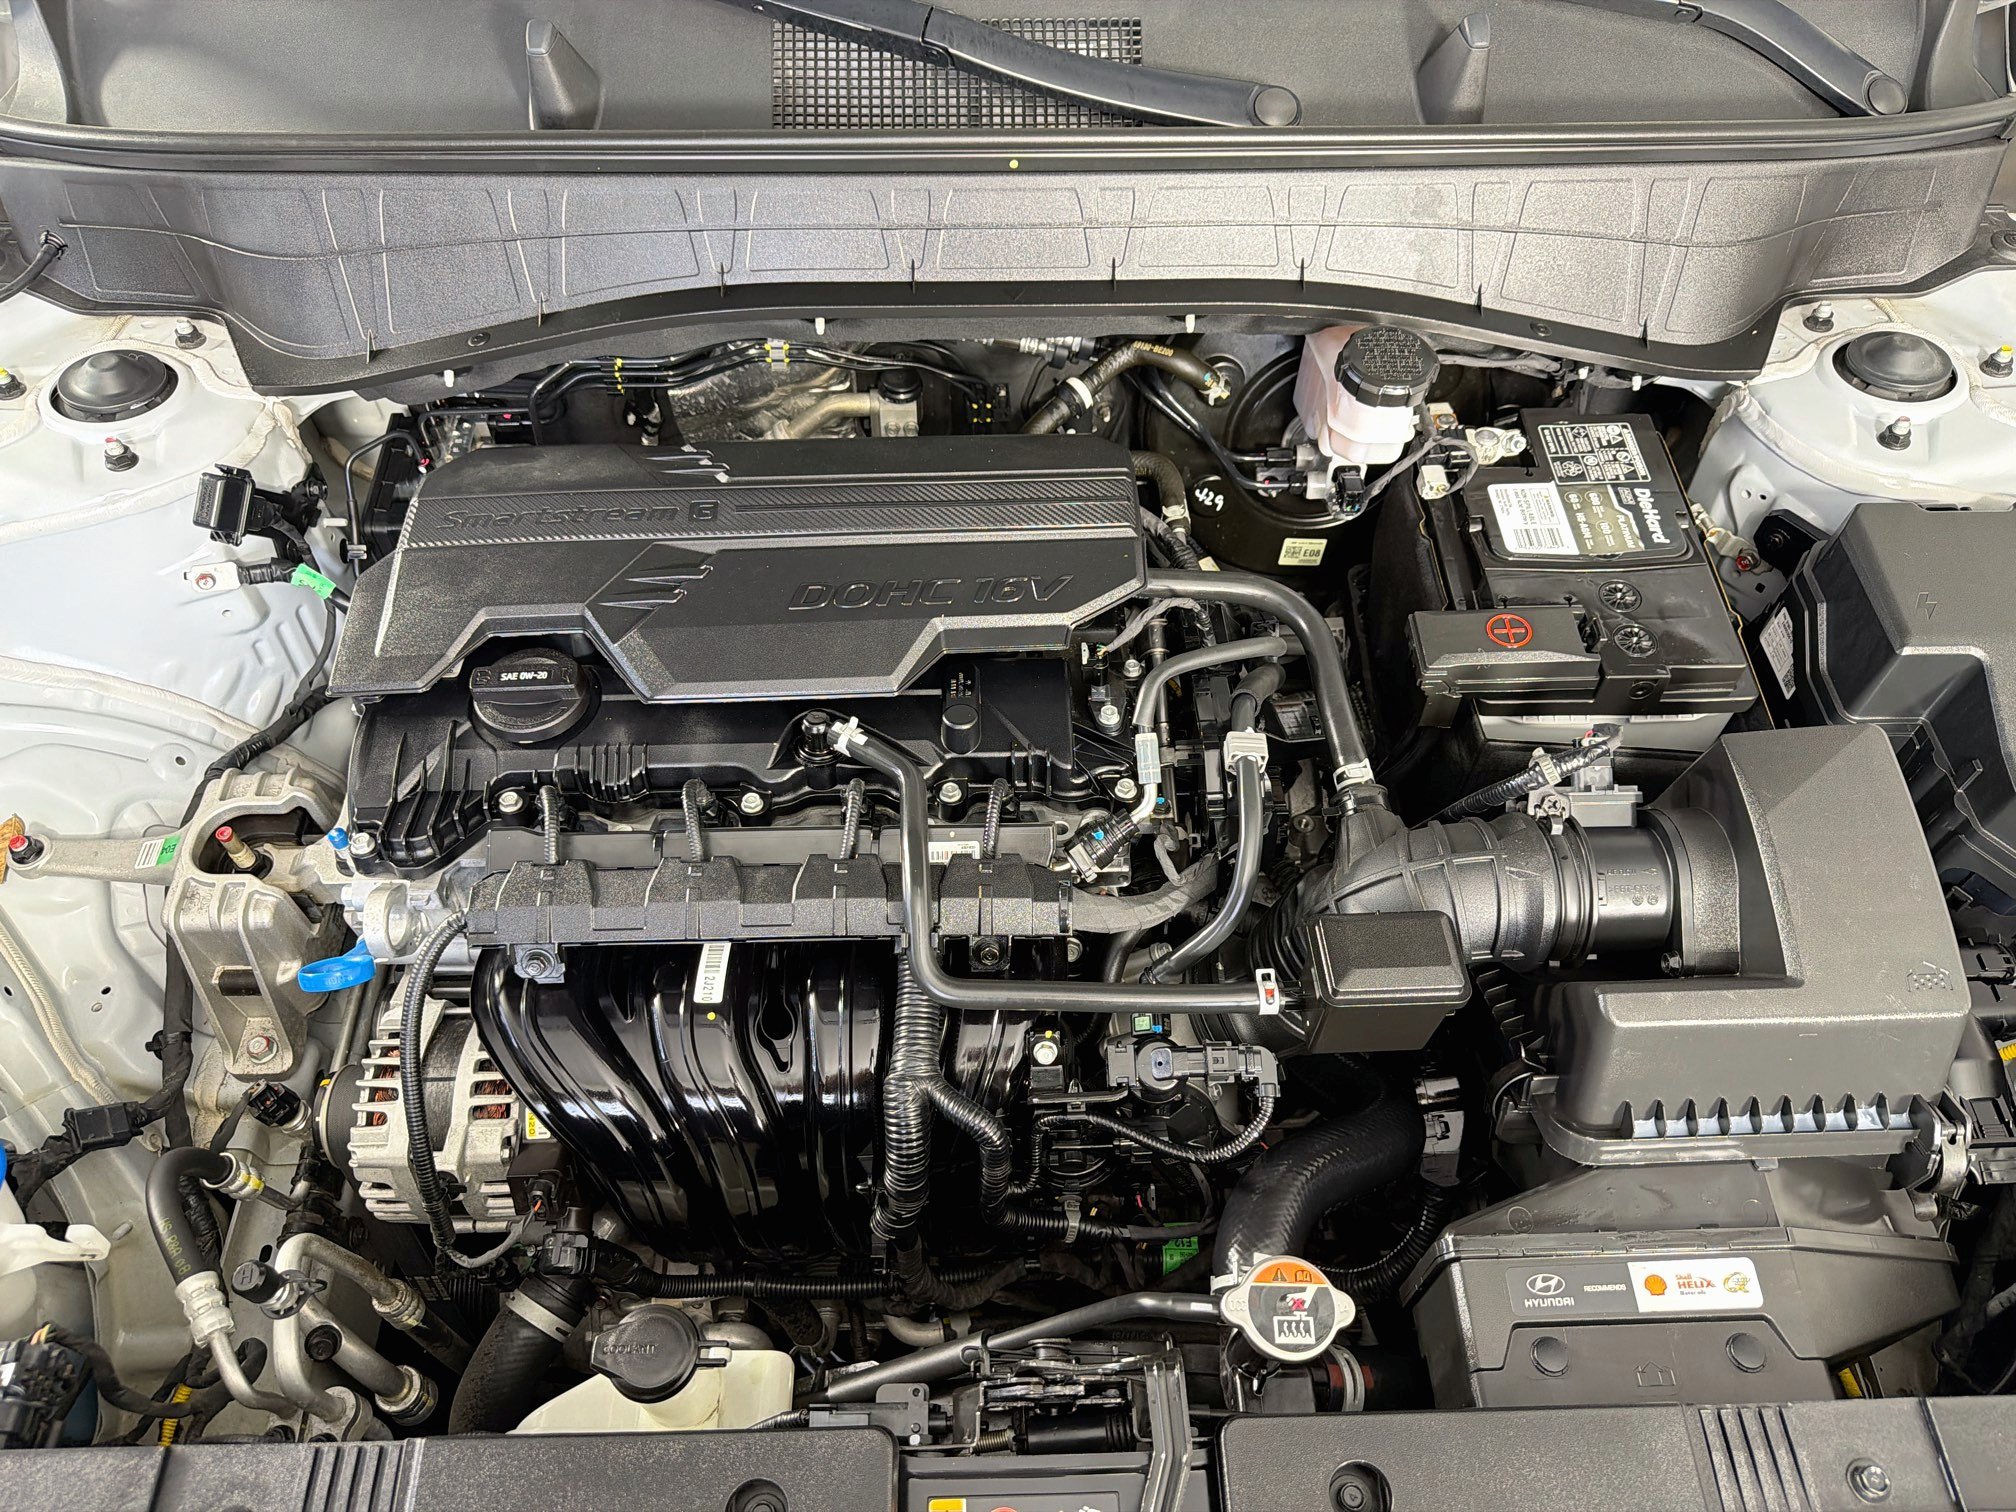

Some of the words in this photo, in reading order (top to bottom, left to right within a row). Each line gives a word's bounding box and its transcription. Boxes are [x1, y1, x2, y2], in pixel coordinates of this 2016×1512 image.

[1194, 487, 1224, 512] 429
[436, 506, 680, 529] Smartstream
[1634, 488, 1670, 544] DieHard
[1616, 515, 1636, 548] PLATINUM
[1303, 548, 1321, 557] E08
[788, 579, 961, 610] DOHC
[974, 575, 1074, 604] 16V
[500, 672, 519, 681] SAE
[520, 671, 548, 680] 0W-20
[702, 976, 715, 1001] 2J210
[1583, 1283, 1627, 1292] RECOMMENDS
[1678, 1279, 1716, 1289] HELIX
[1524, 1297, 1575, 1308] HYUNDAI
[603, 1343, 657, 1355] COOLANT
